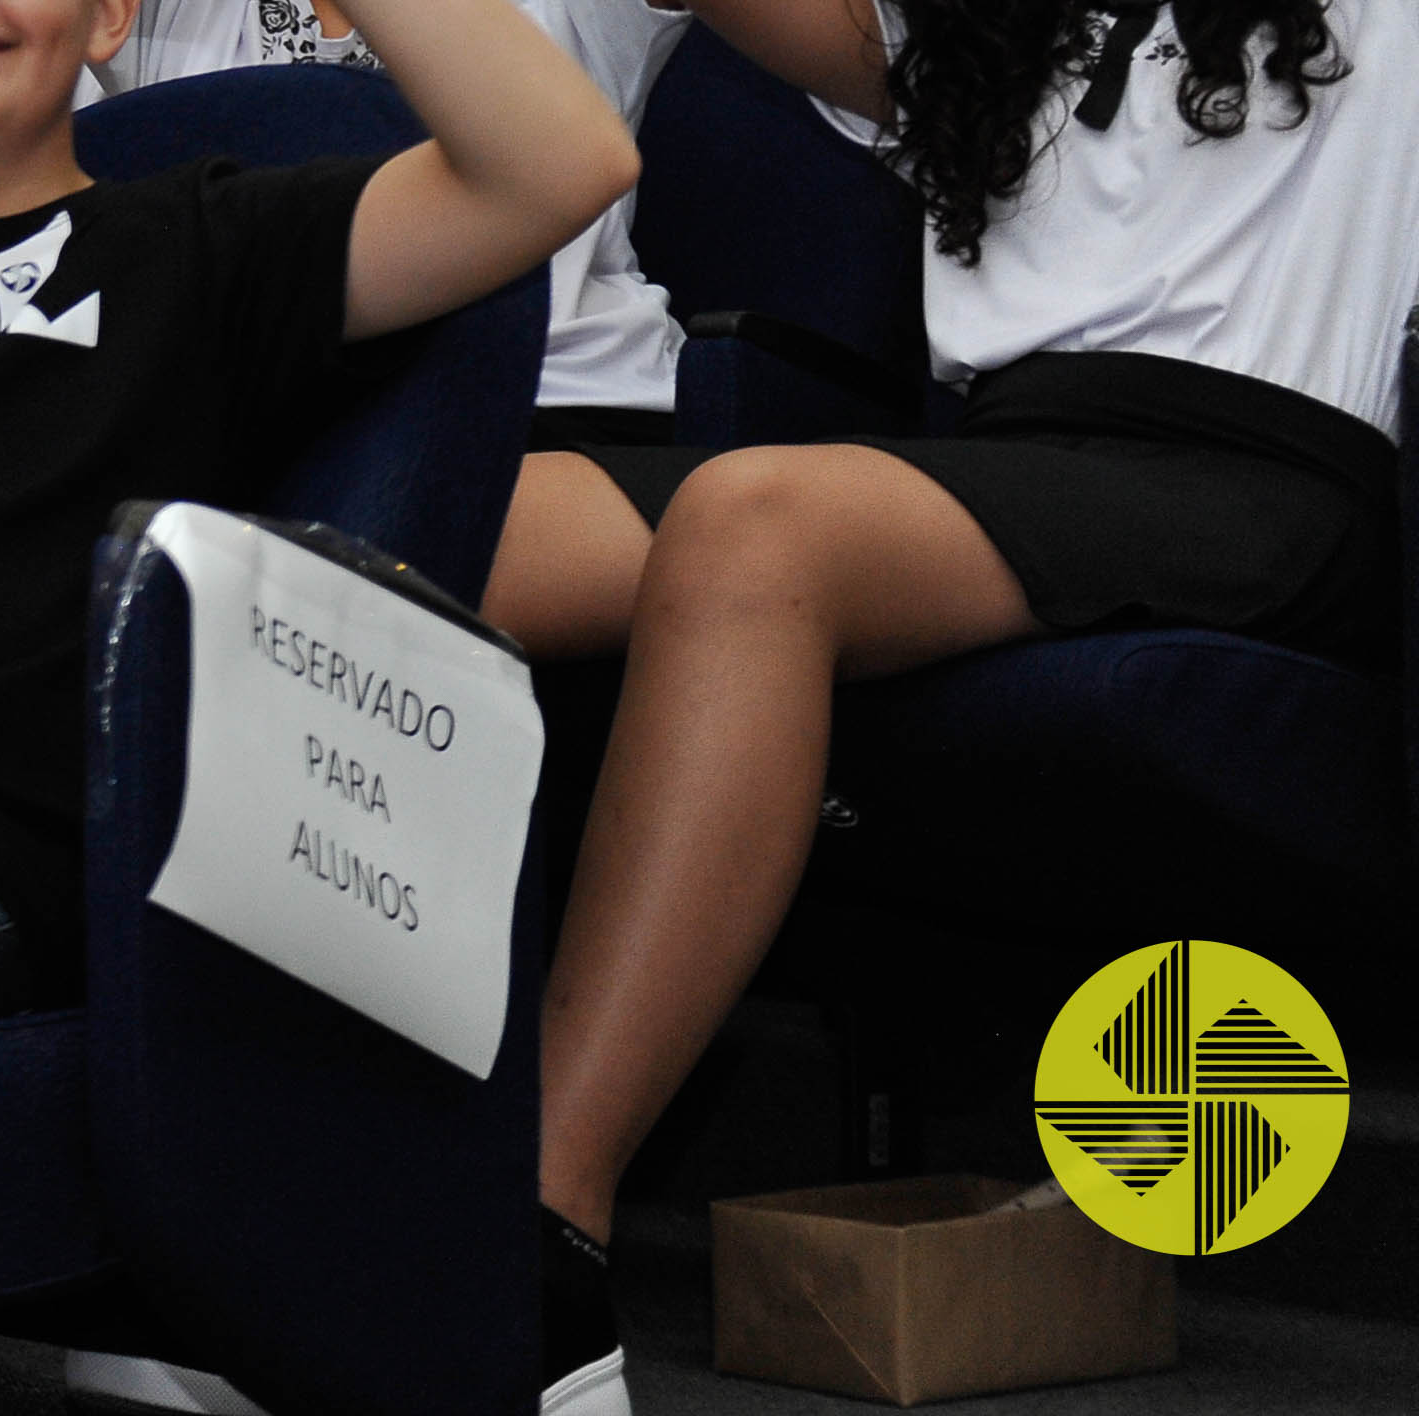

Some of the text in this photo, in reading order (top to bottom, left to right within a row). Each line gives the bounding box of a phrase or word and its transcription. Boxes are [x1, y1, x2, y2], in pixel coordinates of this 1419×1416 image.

[248, 604, 457, 753] RESERVADO
[304, 733, 391, 823] PARA
[288, 821, 420, 933] ALUNOS
